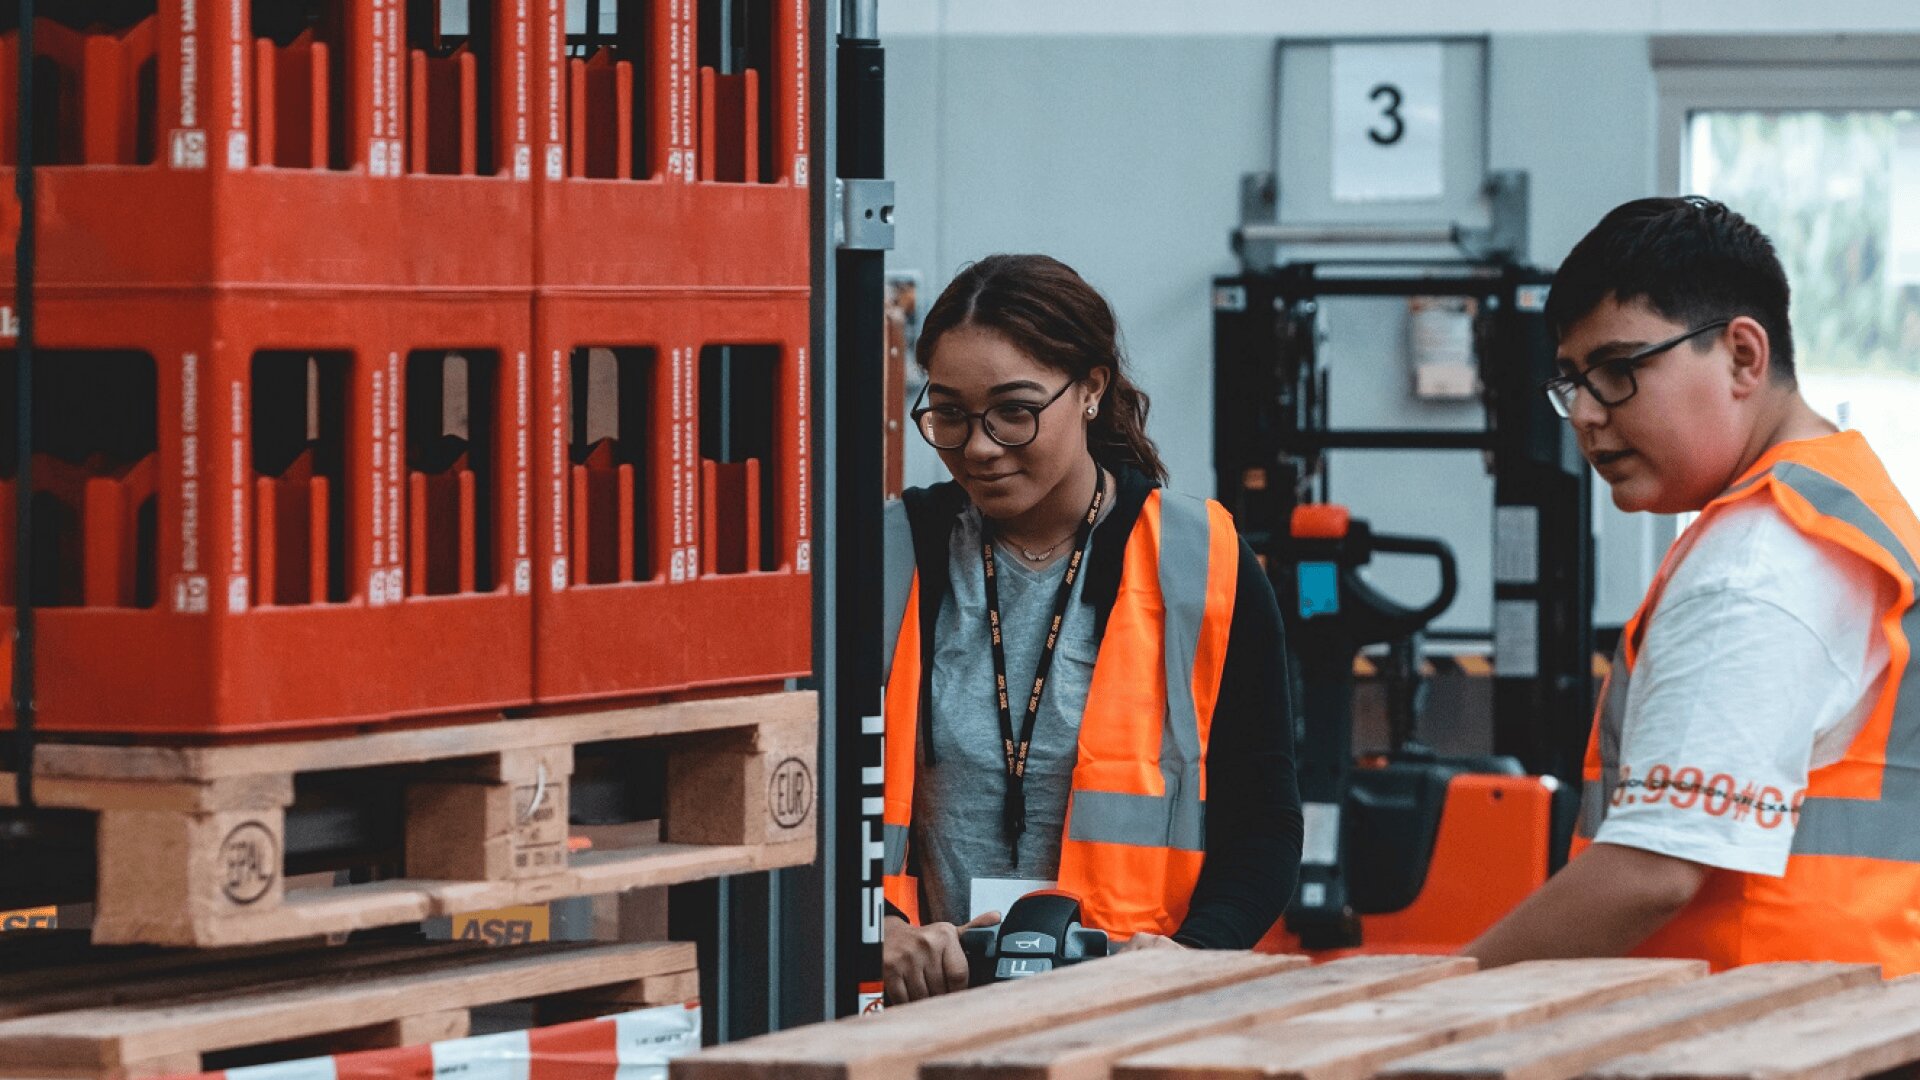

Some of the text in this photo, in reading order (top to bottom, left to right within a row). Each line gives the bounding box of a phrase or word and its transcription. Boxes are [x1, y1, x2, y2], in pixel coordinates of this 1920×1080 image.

[181, 0, 197, 127] BOUTEILLES SAN
[548, 14, 559, 62] SENZA
[670, 22, 679, 60] SANS
[683, 24, 691, 71] SENZA
[796, 33, 804, 69] SANS
[548, 66, 559, 141] BOTTIGLIE
[683, 75, 691, 146] BOTTIGLIE
[796, 72, 804, 151] BOUTEILLES
[1369, 84, 1405, 147] 3
[517, 352, 527, 555] BOUTEILLES SANS CONSIGNE
[552, 427, 562, 475] SENZA
[672, 348, 681, 545] BOUTEILLES SANS CONSIGNE
[685, 346, 693, 542] BOTTIGLIE SENZA DEPOSITO
[798, 347, 806, 537] BOUTEILLES SANS CONSIGNE
[552, 479, 562, 554] BOTTIGLIE
[777, 771, 804, 816] EUR
[861, 686, 885, 944] STILL
